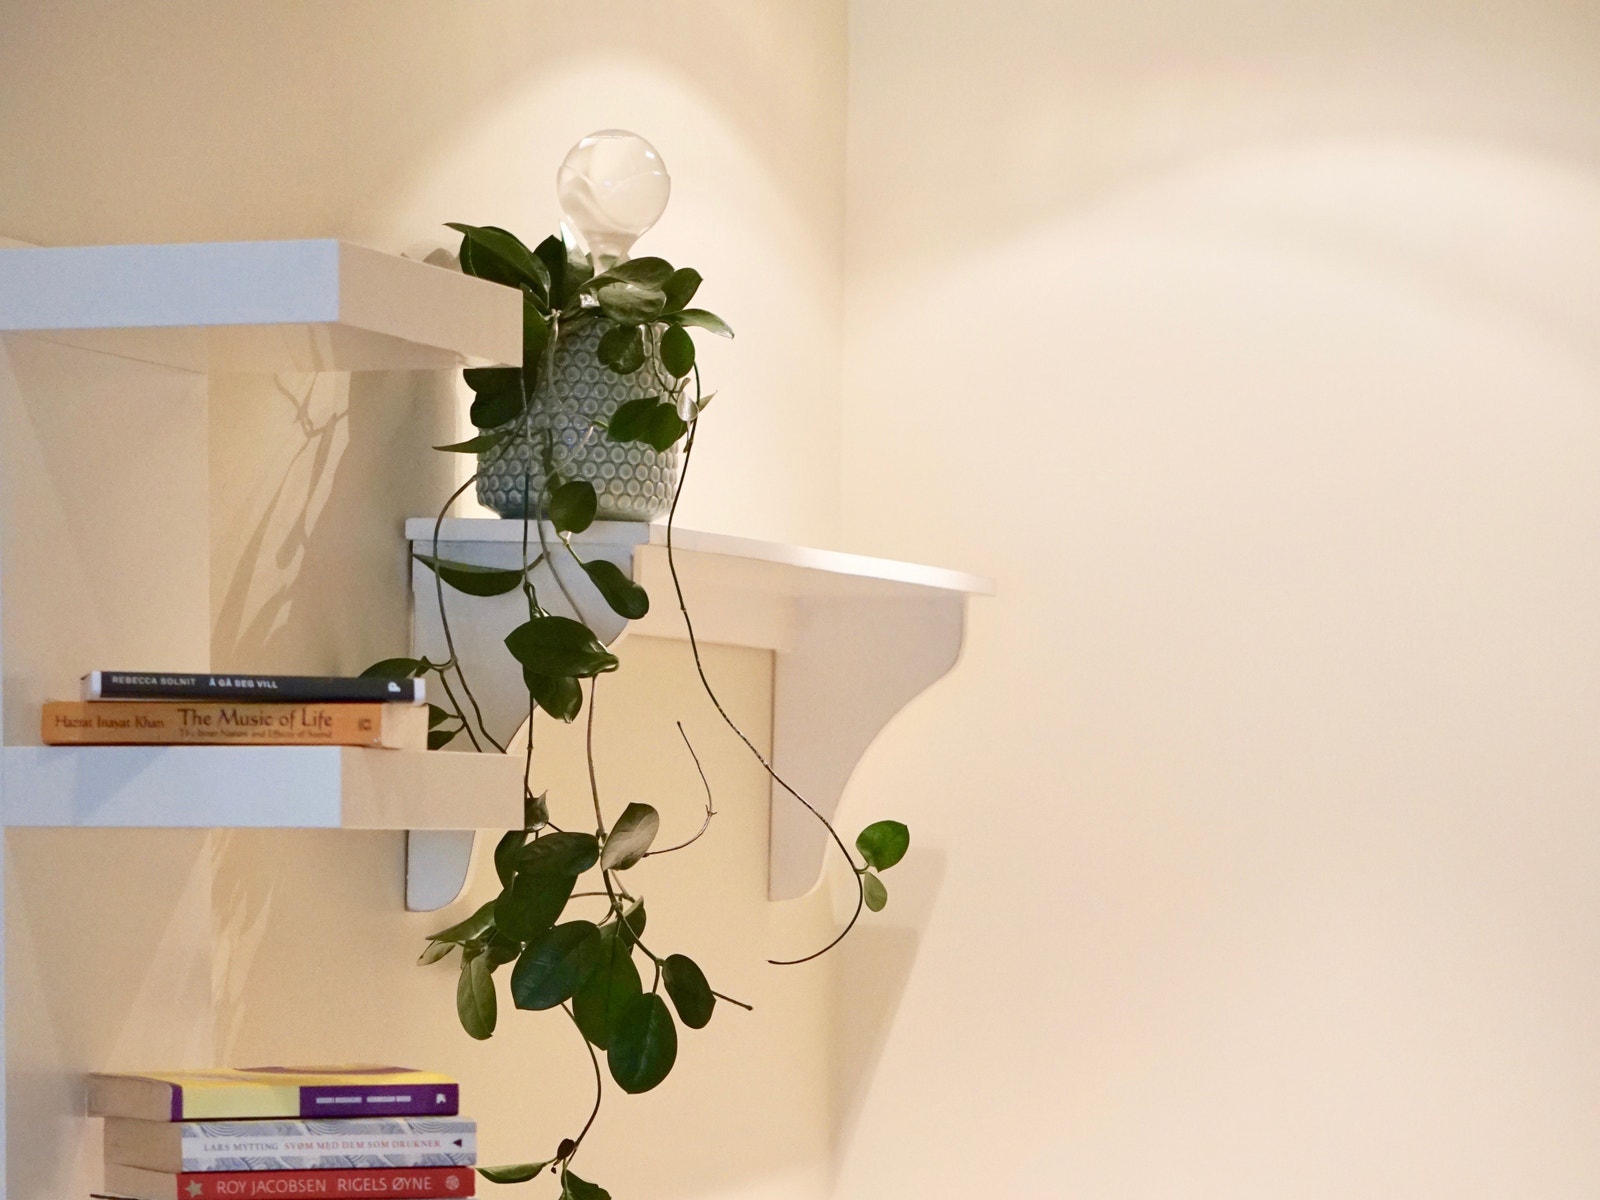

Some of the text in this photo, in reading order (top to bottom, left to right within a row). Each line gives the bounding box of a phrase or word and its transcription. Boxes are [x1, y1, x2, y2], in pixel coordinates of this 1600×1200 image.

[112, 675, 157, 686] REBECCA
[160, 676, 197, 687] SOLNIT
[218, 677, 232, 688] GÅ
[234, 679, 254, 689] SEG
[256, 679, 278, 690] VILL
[135, 714, 165, 729] Khan
[177, 707, 333, 731] The Music of Life
[203, 1142, 231, 1152] LARS
[233, 1142, 279, 1152] MYTTING
[316, 1141, 339, 1150] MED
[342, 1140, 365, 1149] DEM
[367, 1140, 389, 1149] SOM
[392, 1139, 441, 1149] DRUKNER
[216, 1176, 432, 1196] ROY JACOBSEN RIGELS ØYNE
